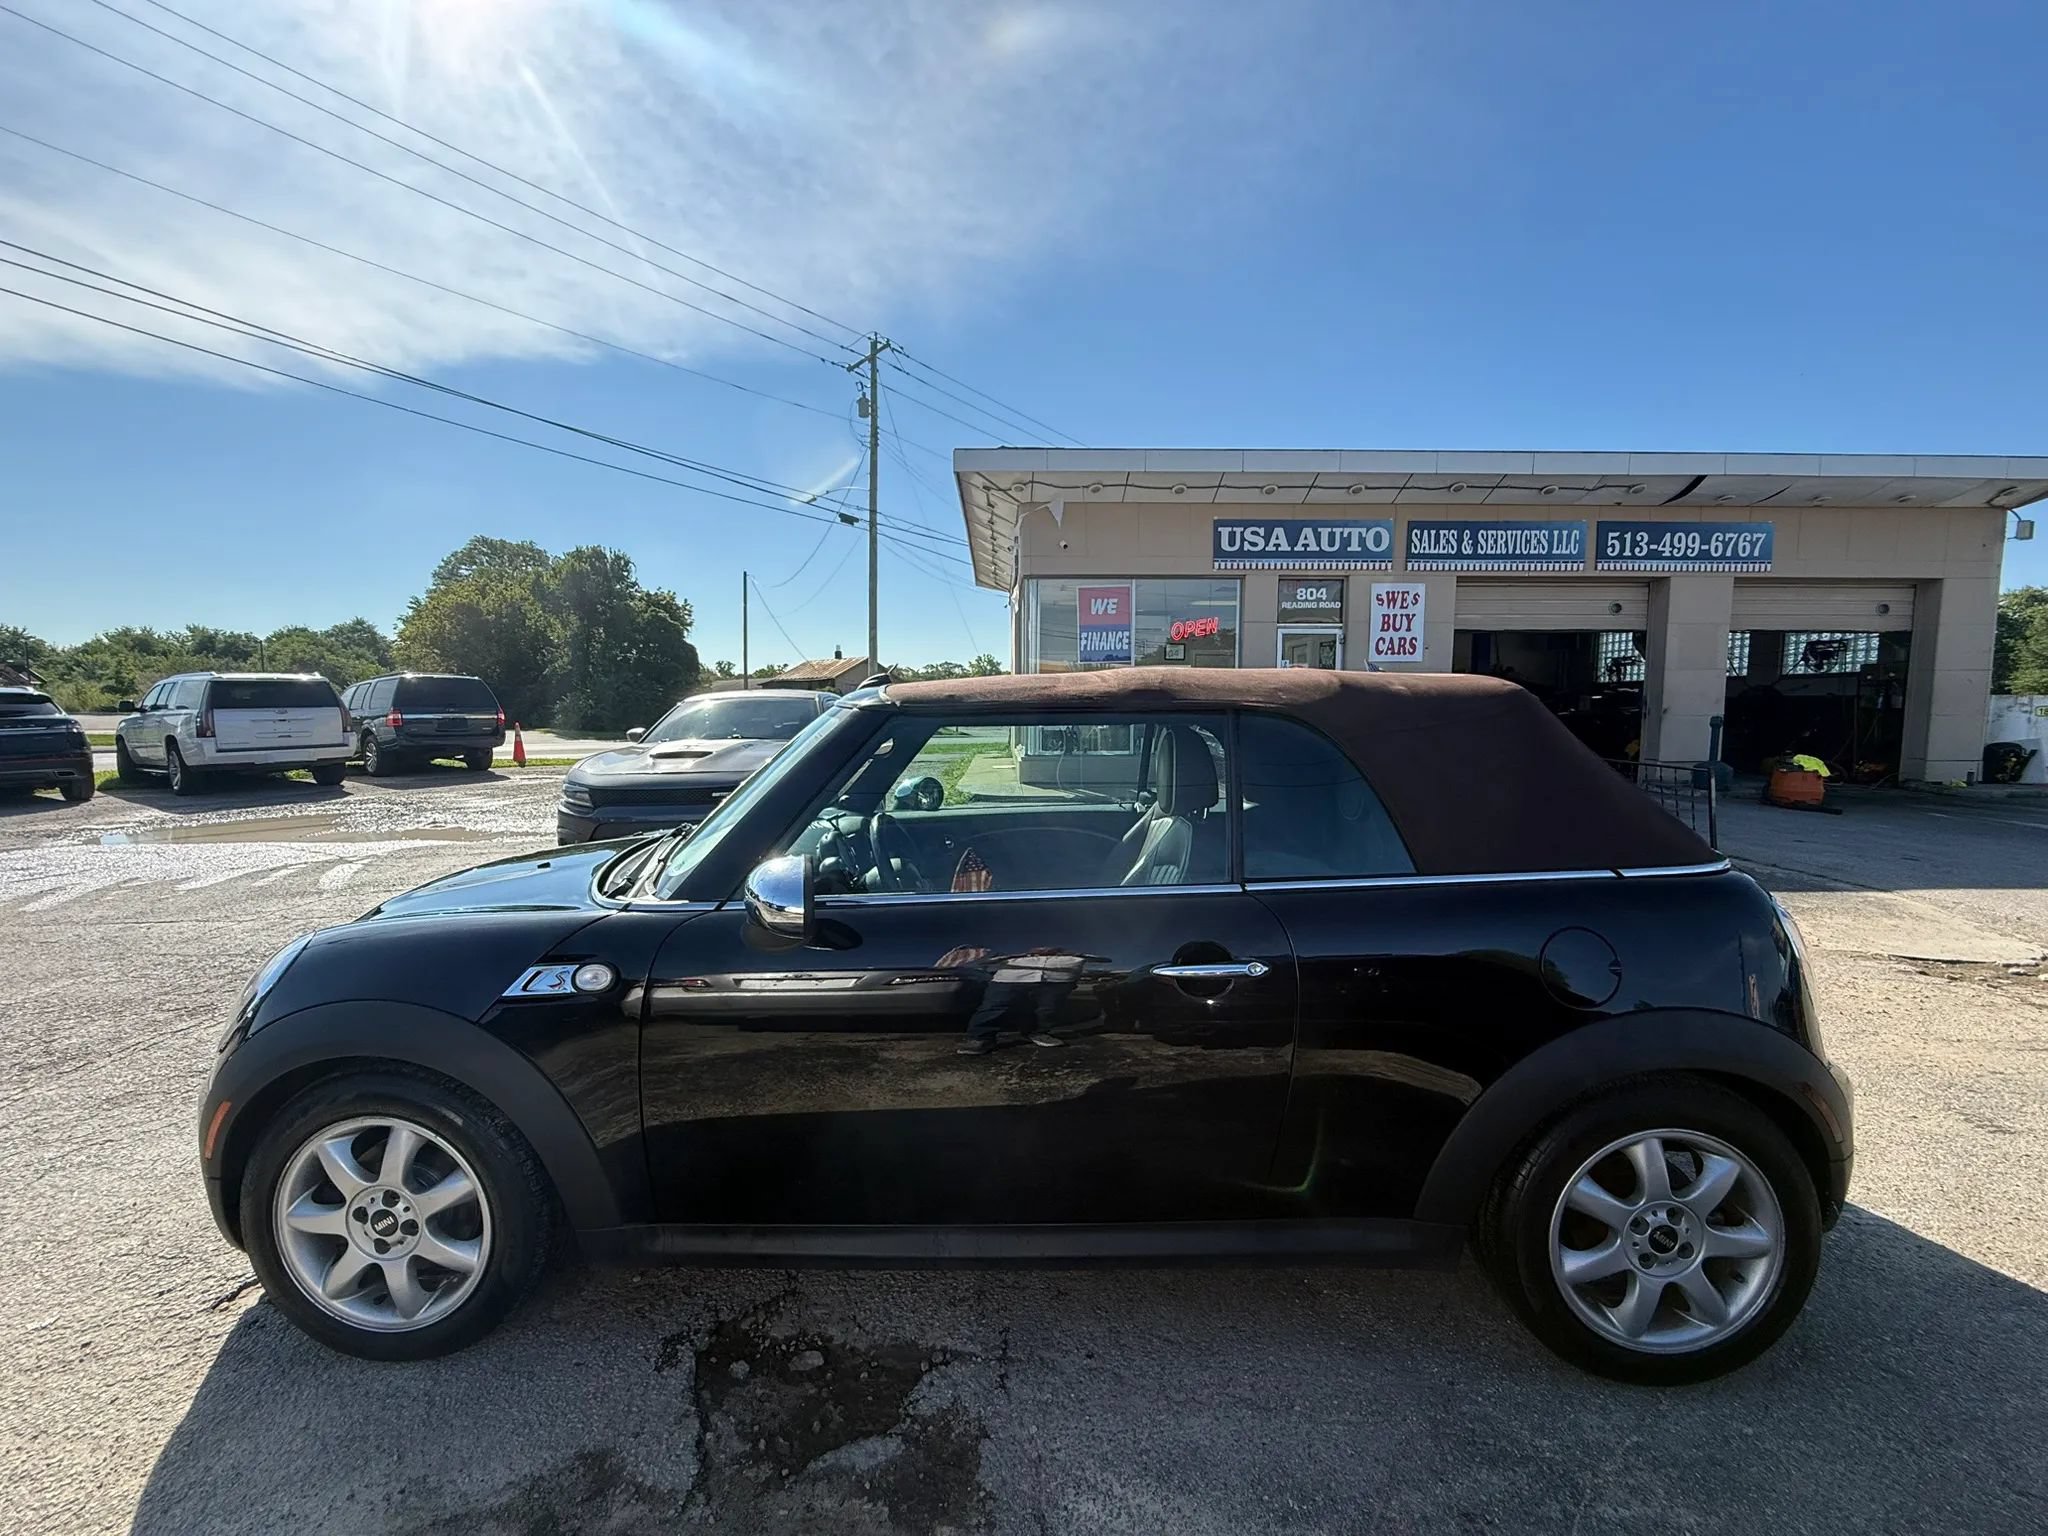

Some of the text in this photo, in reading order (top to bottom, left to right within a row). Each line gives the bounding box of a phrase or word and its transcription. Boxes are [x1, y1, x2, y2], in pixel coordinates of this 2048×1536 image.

[1217, 526, 1390, 552] USA AUTO
[1411, 528, 1580, 555] SALES & SERVICES LLC
[1606, 531, 1767, 557] 513-499-6767
[1296, 587, 1327, 600] 804
[1091, 598, 1119, 615] WE
[1281, 601, 1342, 609] READING ROAD
[1170, 617, 1219, 641] OPEN
[1380, 613, 1416, 632] BUY
[1081, 631, 1130, 651] FINANCE
[1375, 636, 1418, 656] CARS
[374, 1215, 395, 1232] MINI
